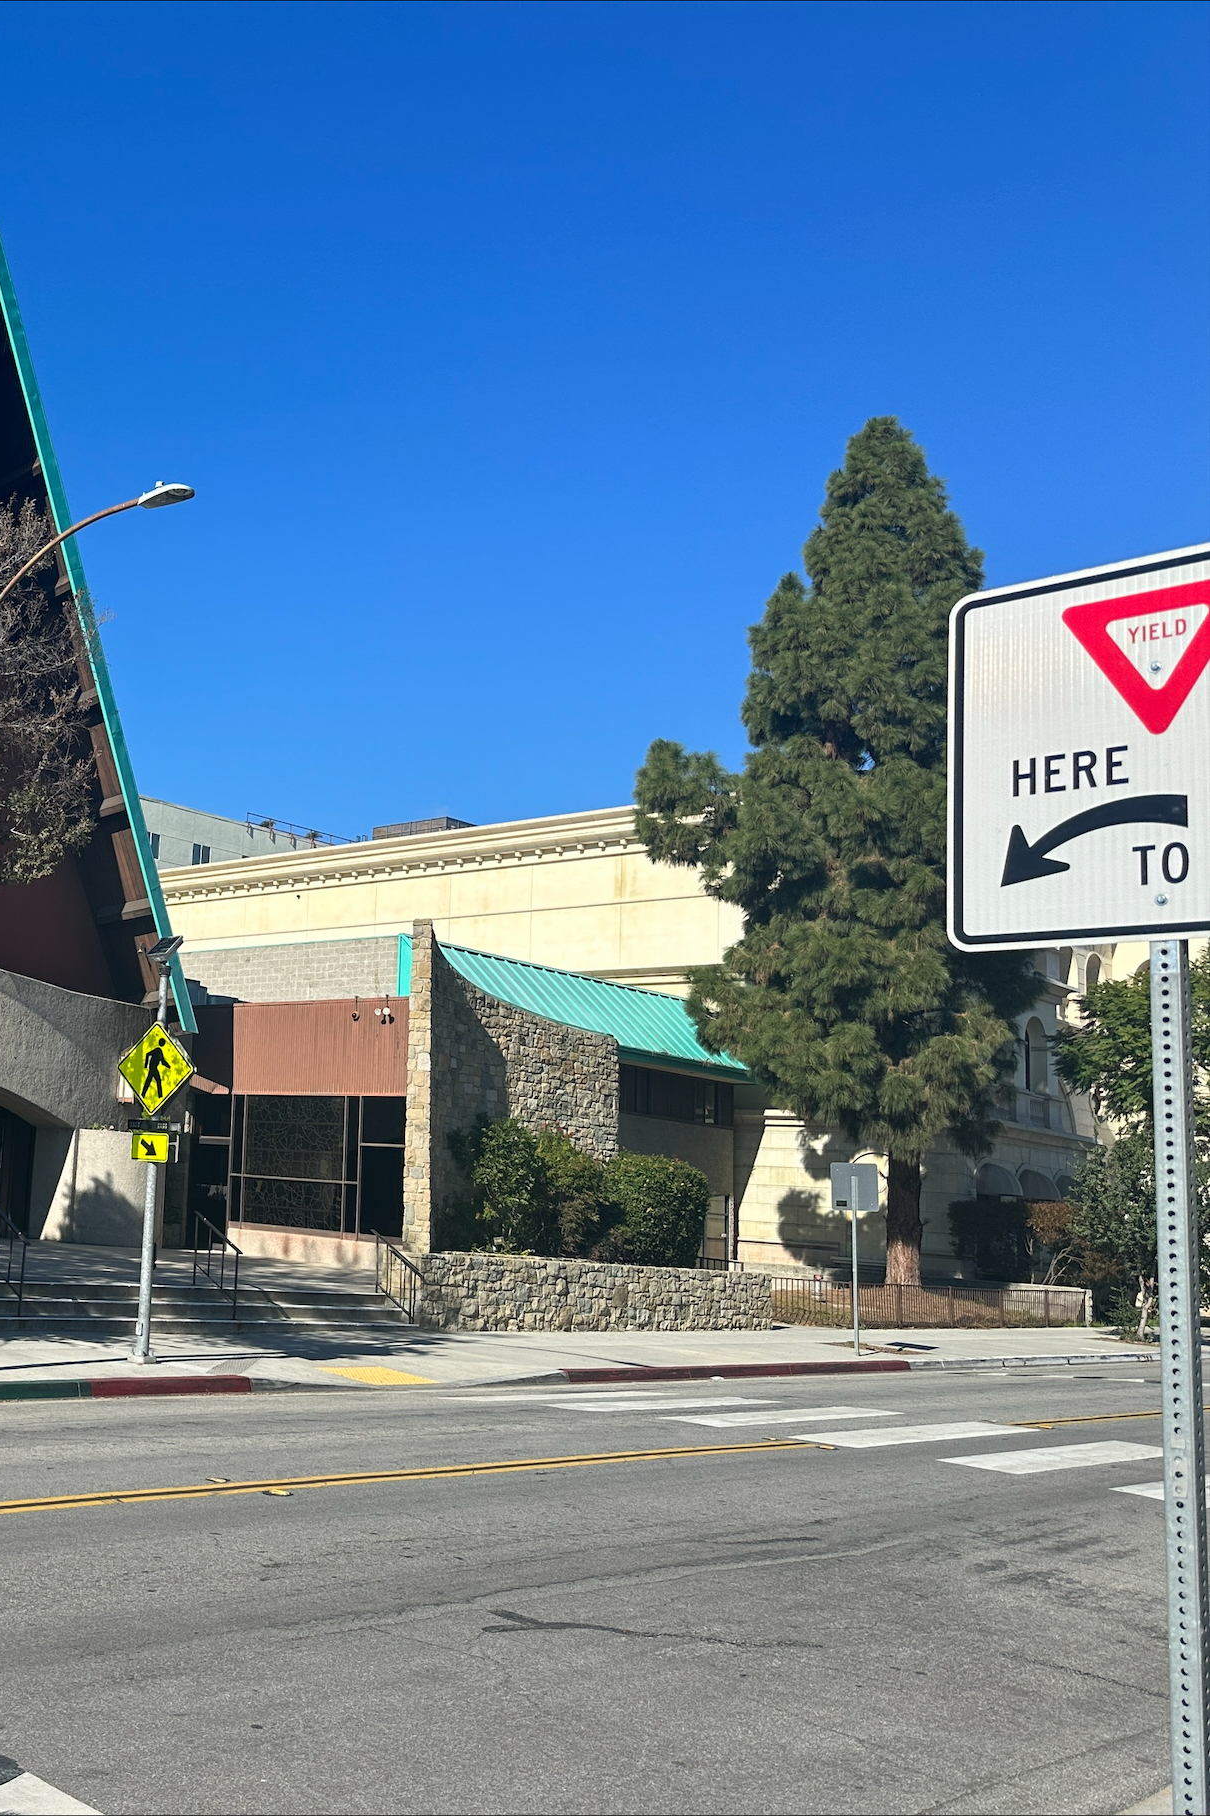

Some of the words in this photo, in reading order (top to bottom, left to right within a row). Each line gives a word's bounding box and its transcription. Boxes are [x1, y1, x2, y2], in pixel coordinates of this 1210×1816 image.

[1128, 619, 1187, 644] YIELD
[1012, 745, 1129, 797] HERE
[1132, 842, 1189, 885] TO
